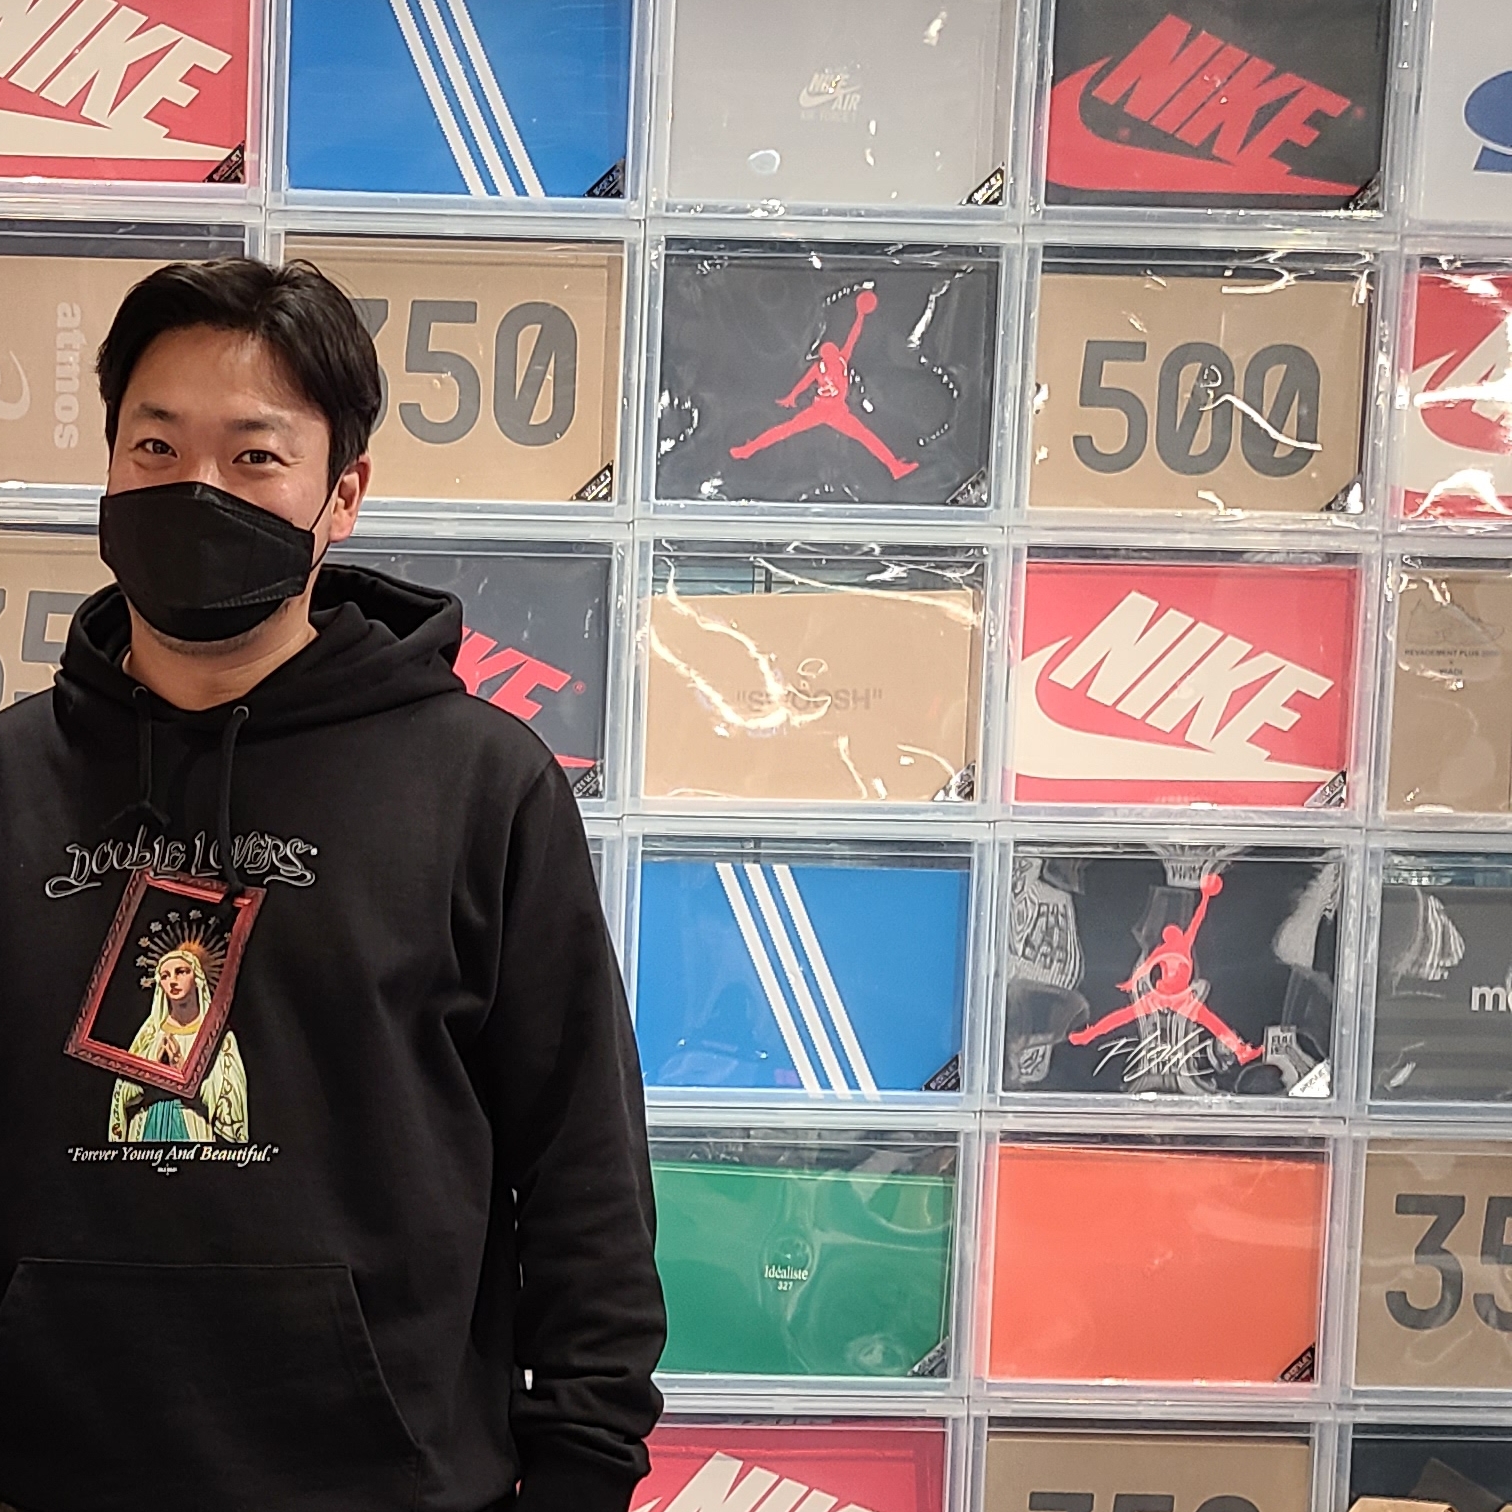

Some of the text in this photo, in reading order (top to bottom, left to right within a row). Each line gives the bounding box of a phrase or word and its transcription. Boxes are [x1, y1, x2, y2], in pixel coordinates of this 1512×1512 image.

[832, 93, 861, 111] AIR
[1092, 14, 1351, 174] NIKE
[53, 301, 88, 449] atmos
[1072, 340, 1323, 477] 500
[452, 626, 571, 721] KE
[1049, 591, 1335, 762] NIKE
[121, 1146, 162, 1166] Young
[165, 1144, 200, 1161] And
[777, 1281, 793, 1291] 327
